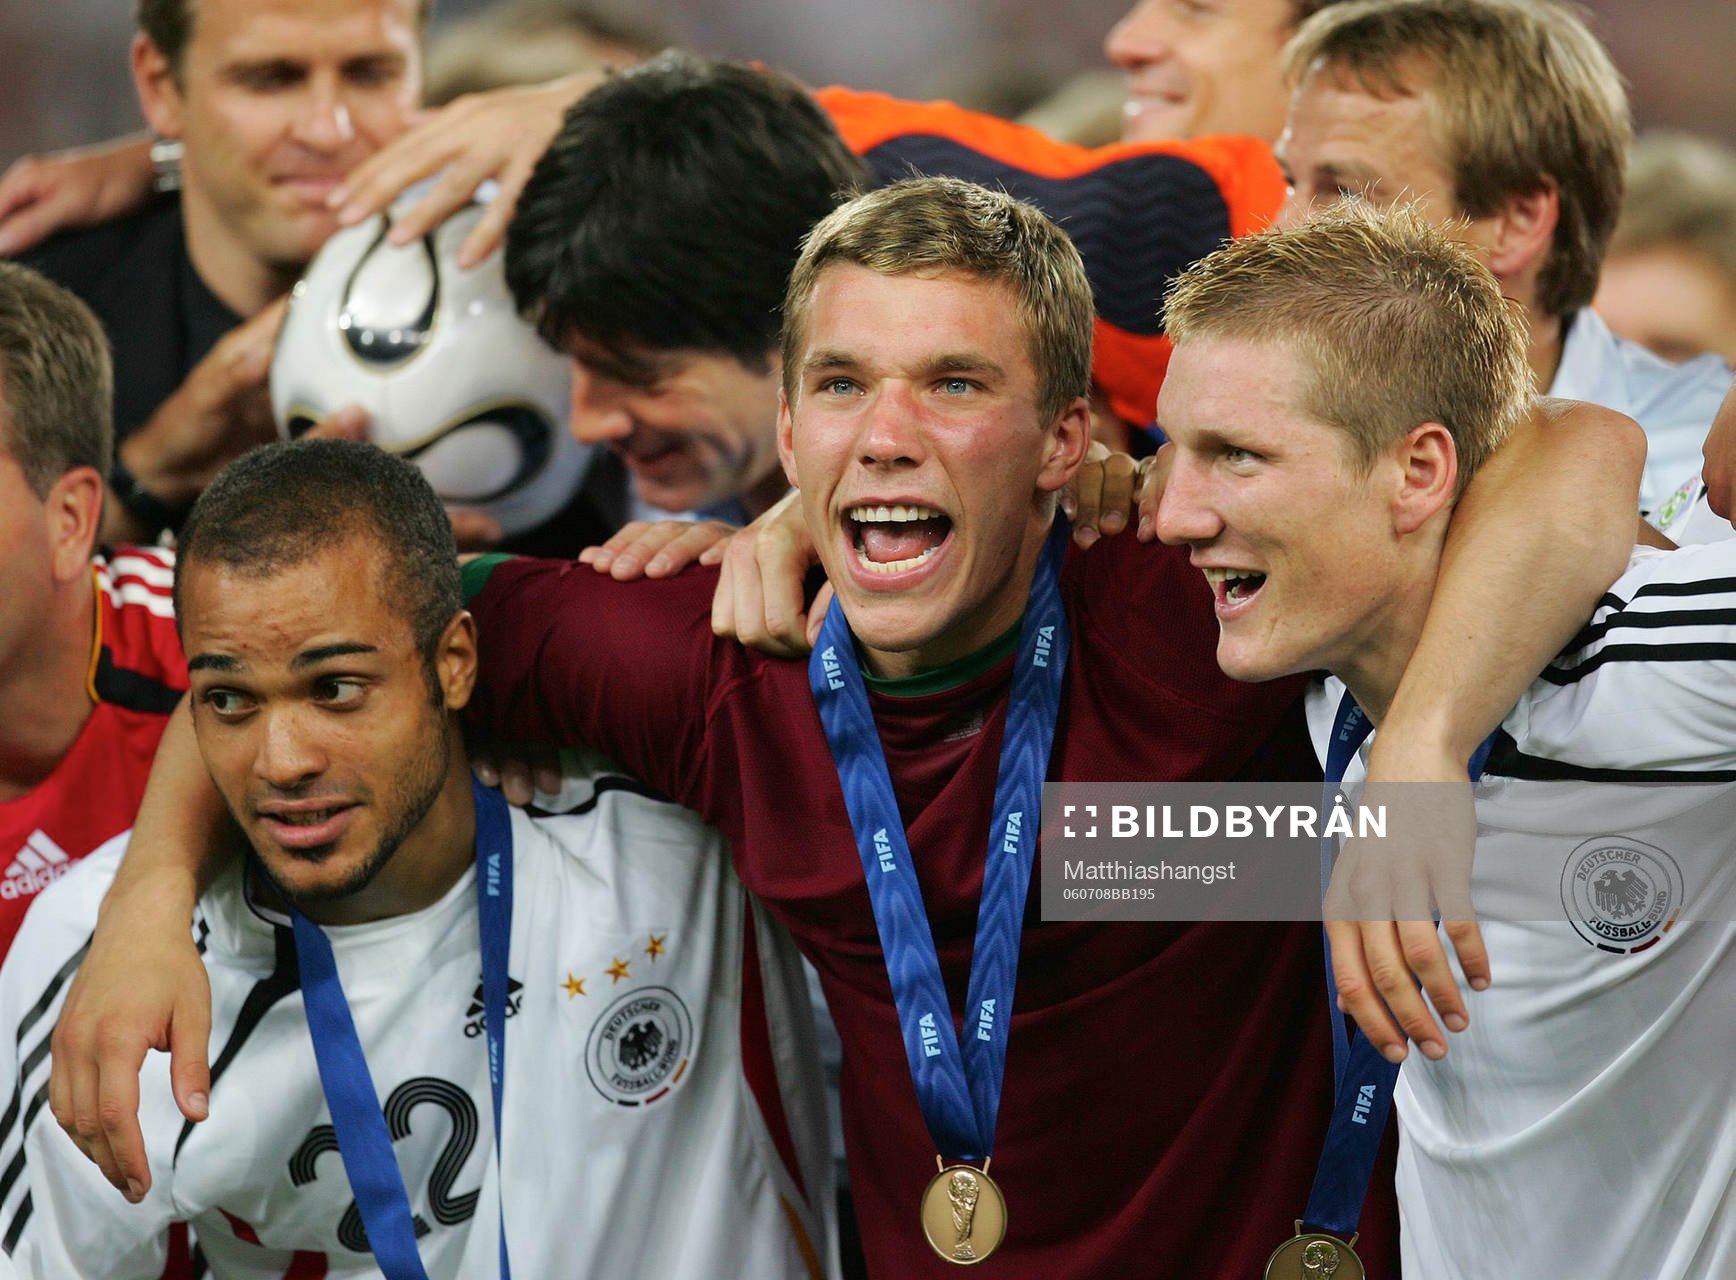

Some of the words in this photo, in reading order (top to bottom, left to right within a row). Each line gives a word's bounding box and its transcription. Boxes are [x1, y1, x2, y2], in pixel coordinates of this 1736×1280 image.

[821, 645, 845, 691] FIFA
[1033, 625, 1056, 668] FIFA
[873, 828, 897, 873] FIFA
[1003, 811, 1023, 854] FIFA
[487, 853, 500, 897] FIFA
[1577, 850, 1642, 881] DEUTSCHER
[919, 1012, 941, 1057] FIFA
[977, 999, 996, 1041] FIFA
[1352, 1085, 1376, 1125] FIFA
